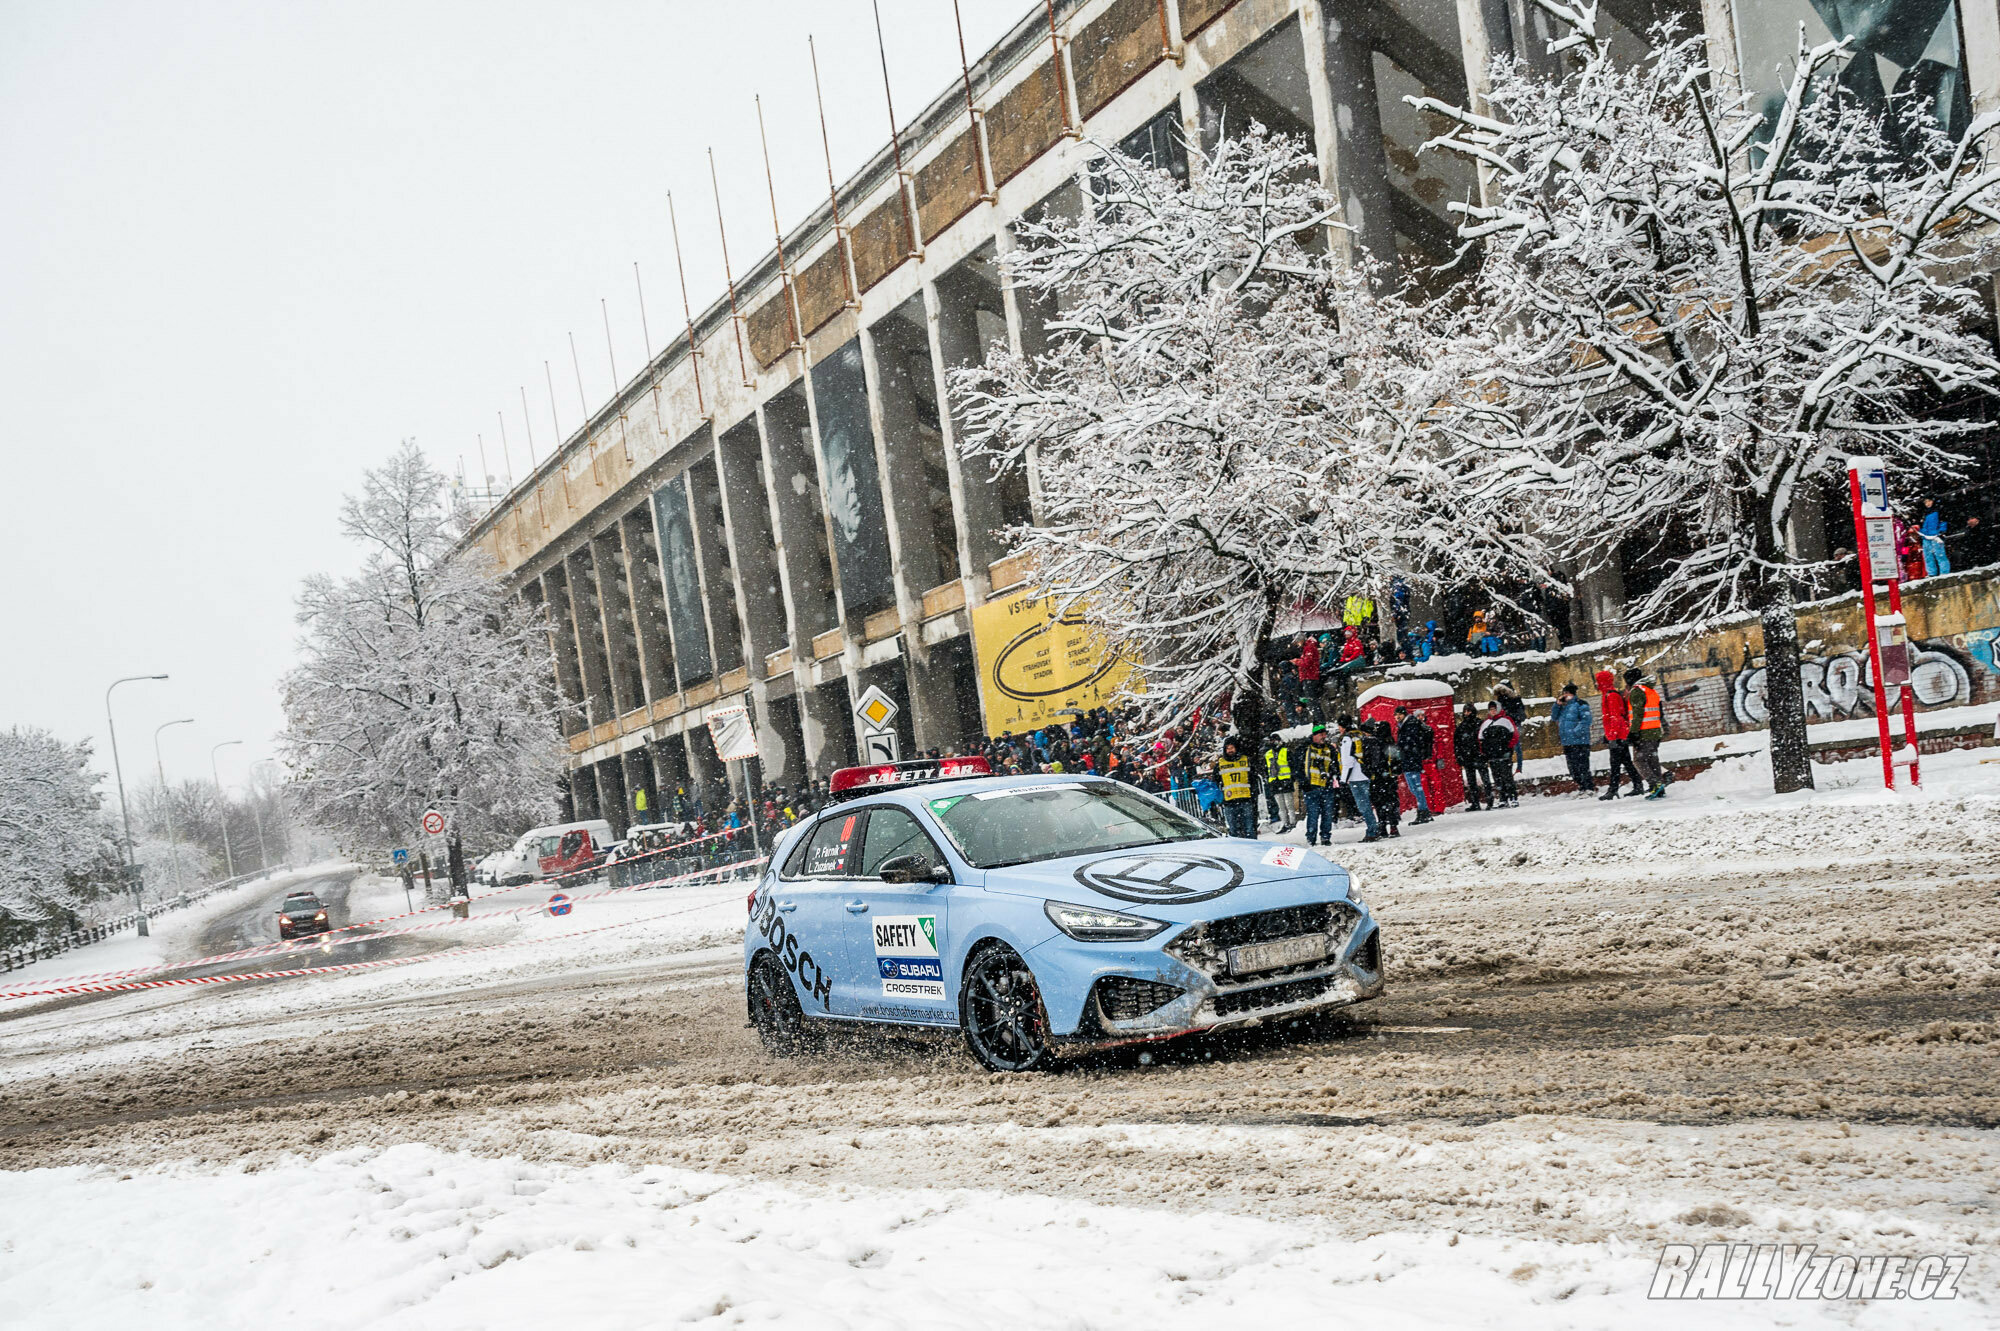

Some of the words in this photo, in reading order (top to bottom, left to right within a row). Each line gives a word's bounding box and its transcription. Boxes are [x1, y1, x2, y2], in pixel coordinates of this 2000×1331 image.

[867, 768, 935, 784] SAFETY
[938, 764, 974, 777] CAR
[876, 924, 916, 947] SAFETY
[760, 896, 832, 1012] BOSCH
[900, 964, 941, 977] SUBARU
[885, 983, 943, 996] CROSSTREK
[861, 1003, 957, 1021] www.boschaftermarket.cz
